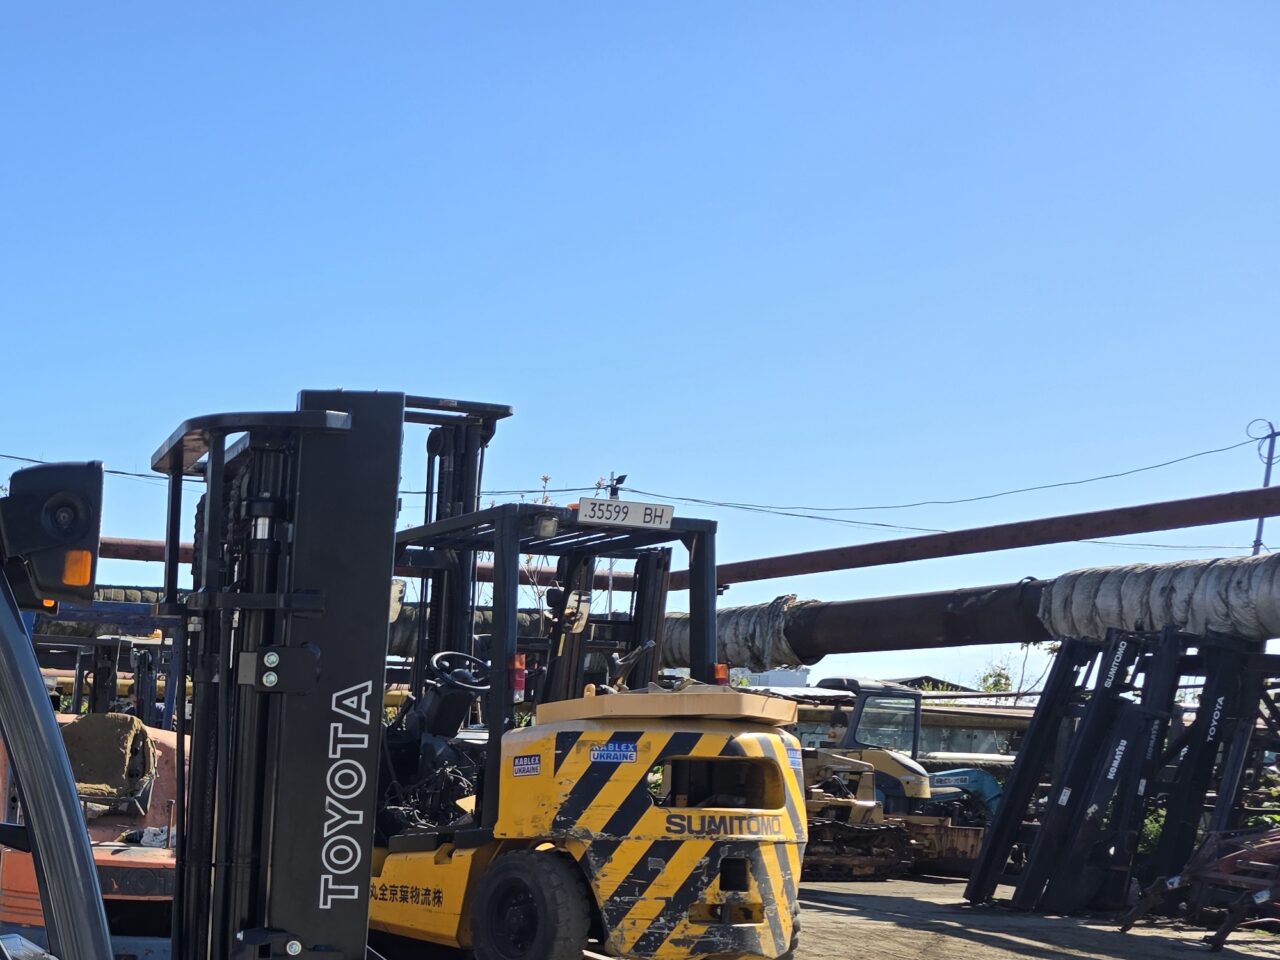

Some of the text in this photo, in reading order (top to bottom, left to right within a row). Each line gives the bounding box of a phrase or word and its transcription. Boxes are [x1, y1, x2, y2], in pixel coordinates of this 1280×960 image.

[588, 502, 665, 525] 35599 BH
[1104, 640, 1128, 689] SUMITOMO
[1206, 696, 1225, 743] TOYOTA
[591, 743, 635, 752] KABLEX
[592, 751, 636, 762] UKRAINE
[514, 756, 540, 766] KABLEX
[514, 765, 540, 775] UKRAINE
[1106, 739, 1128, 780] KOMATSU
[319, 680, 373, 909] TOYOTA
[665, 814, 782, 836] SUMITOMO
